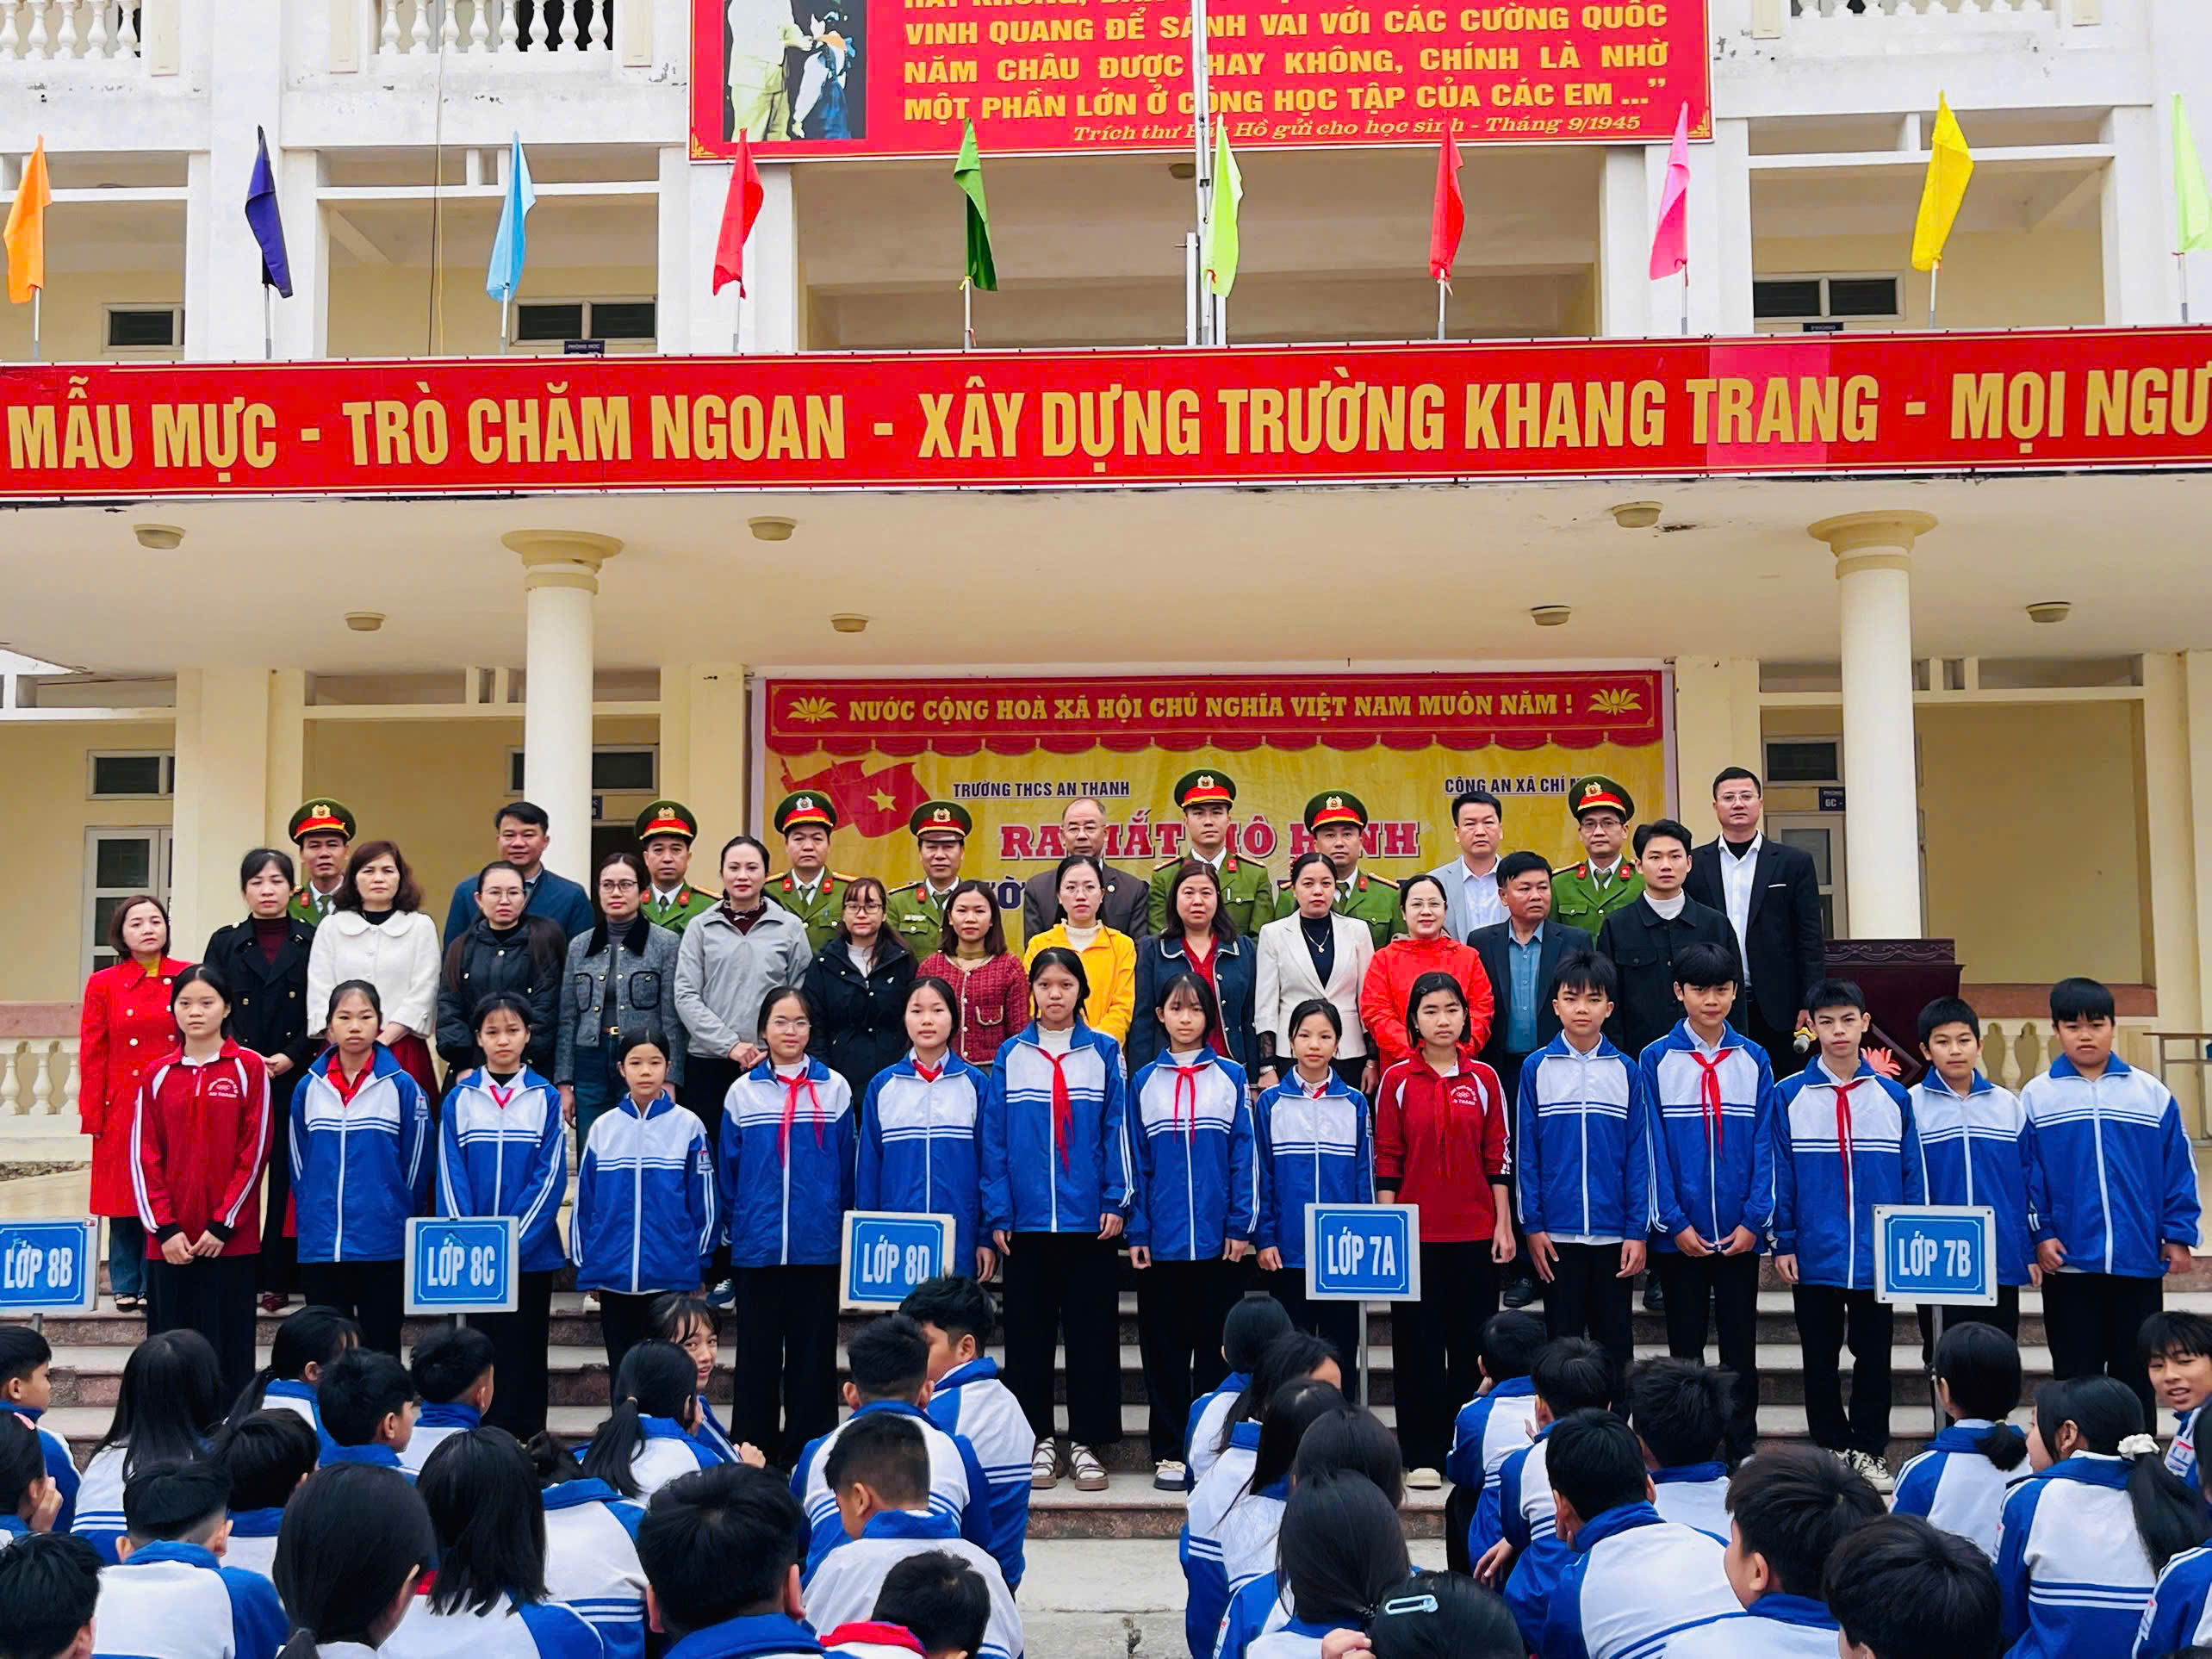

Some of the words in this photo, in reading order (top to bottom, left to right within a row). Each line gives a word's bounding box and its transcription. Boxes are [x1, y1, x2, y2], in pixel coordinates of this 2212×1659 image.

[905, 22, 978, 45] VINH
[990, 19, 1094, 45] QUANG
[1106, 7, 1146, 40] ĐỂ
[1259, 14, 1308, 36] VAI
[1320, 5, 1370, 34] VỚI
[1384, 4, 1447, 33] CÁC
[1461, 2, 1569, 31] CƯỜNG
[904, 55, 978, 84] NĂM
[997, 53, 1080, 81] CHÂU
[1097, 53, 1184, 84] ĐƯỢC
[1208, 53, 1265, 76] HAY
[1284, 45, 1403, 74] KHÔNG,
[1420, 41, 1519, 71] CHÍNH
[1540, 40, 1581, 69] LÀ
[1601, 38, 1668, 68] NHỜ
[904, 92, 970, 125] MỘT
[981, 88, 1066, 119] PHẦN
[1077, 87, 1136, 117] LỚN
[1146, 84, 1168, 115] Ở
[1274, 89, 1337, 117] HỌC
[1346, 82, 1406, 115] TẬP
[1416, 76, 1481, 108] CỦA
[1491, 78, 1554, 107] CÁC
[1564, 83, 1612, 106] EM
[1074, 122, 1135, 141] Trích
[1141, 123, 1182, 140] thư
[1233, 119, 1270, 138] Hồ
[1272, 118, 1313, 140] gửi
[1316, 120, 1358, 136] cho
[1364, 120, 1409, 138] học
[1485, 115, 1563, 134] Tháng
[1568, 115, 1641, 133] 9/1945
[8, 376, 134, 469] MẪU
[152, 396, 276, 482] MỰC
[301, 428, 320, 442] -
[343, 381, 449, 466] TRÒ
[468, 380, 631, 465] CHĂM
[651, 394, 846, 461] NGOAN
[873, 422, 893, 436] -
[918, 376, 1025, 458] XÂY
[1042, 383, 1201, 473] DỰNG
[1217, 365, 1445, 454] TRƯỜNG
[1464, 380, 1666, 450] KHANG
[1686, 374, 1880, 445] TRANG
[1904, 401, 1927, 416] -
[1950, 370, 2066, 455] MỌI
[849, 696, 914, 722] NƯỚC
[923, 695, 989, 725] CỘNG
[997, 694, 1047, 720] HOÀ
[1054, 693, 1090, 719] XÃ
[1097, 694, 1142, 723] HỘI
[1150, 692, 1197, 718] CHỦ
[1206, 692, 1283, 718] NGHĨA
[1290, 692, 1346, 722] VIỆT
[1355, 696, 1411, 716] NAM
[1419, 690, 1493, 716] MUÔN
[1500, 690, 1557, 714] NĂM
[1566, 694, 1573, 714] !
[954, 779, 1010, 798] TRƯỜNG
[1016, 782, 1052, 797] THCS
[1057, 781, 1077, 796] AN
[1081, 780, 1130, 796] THANH
[1445, 776, 1486, 793] CÔNG
[1490, 778, 1511, 792] AN
[1516, 775, 1536, 792] XÃ
[1540, 774, 1565, 792] CHÍ
[1000, 824, 1066, 858] RA
[4, 1240, 43, 1289] LỚP
[47, 1247, 73, 1288] 8B
[427, 1238, 465, 1286] LỚP
[470, 1246, 496, 1286] 8C
[862, 1234, 900, 1283] LỚP
[904, 1245, 930, 1285] 8D
[1327, 1226, 1364, 1276] LỚP
[1370, 1235, 1396, 1276] 7A
[1898, 1230, 1938, 1277] LỚP
[1943, 1240, 1972, 1277] 7B
